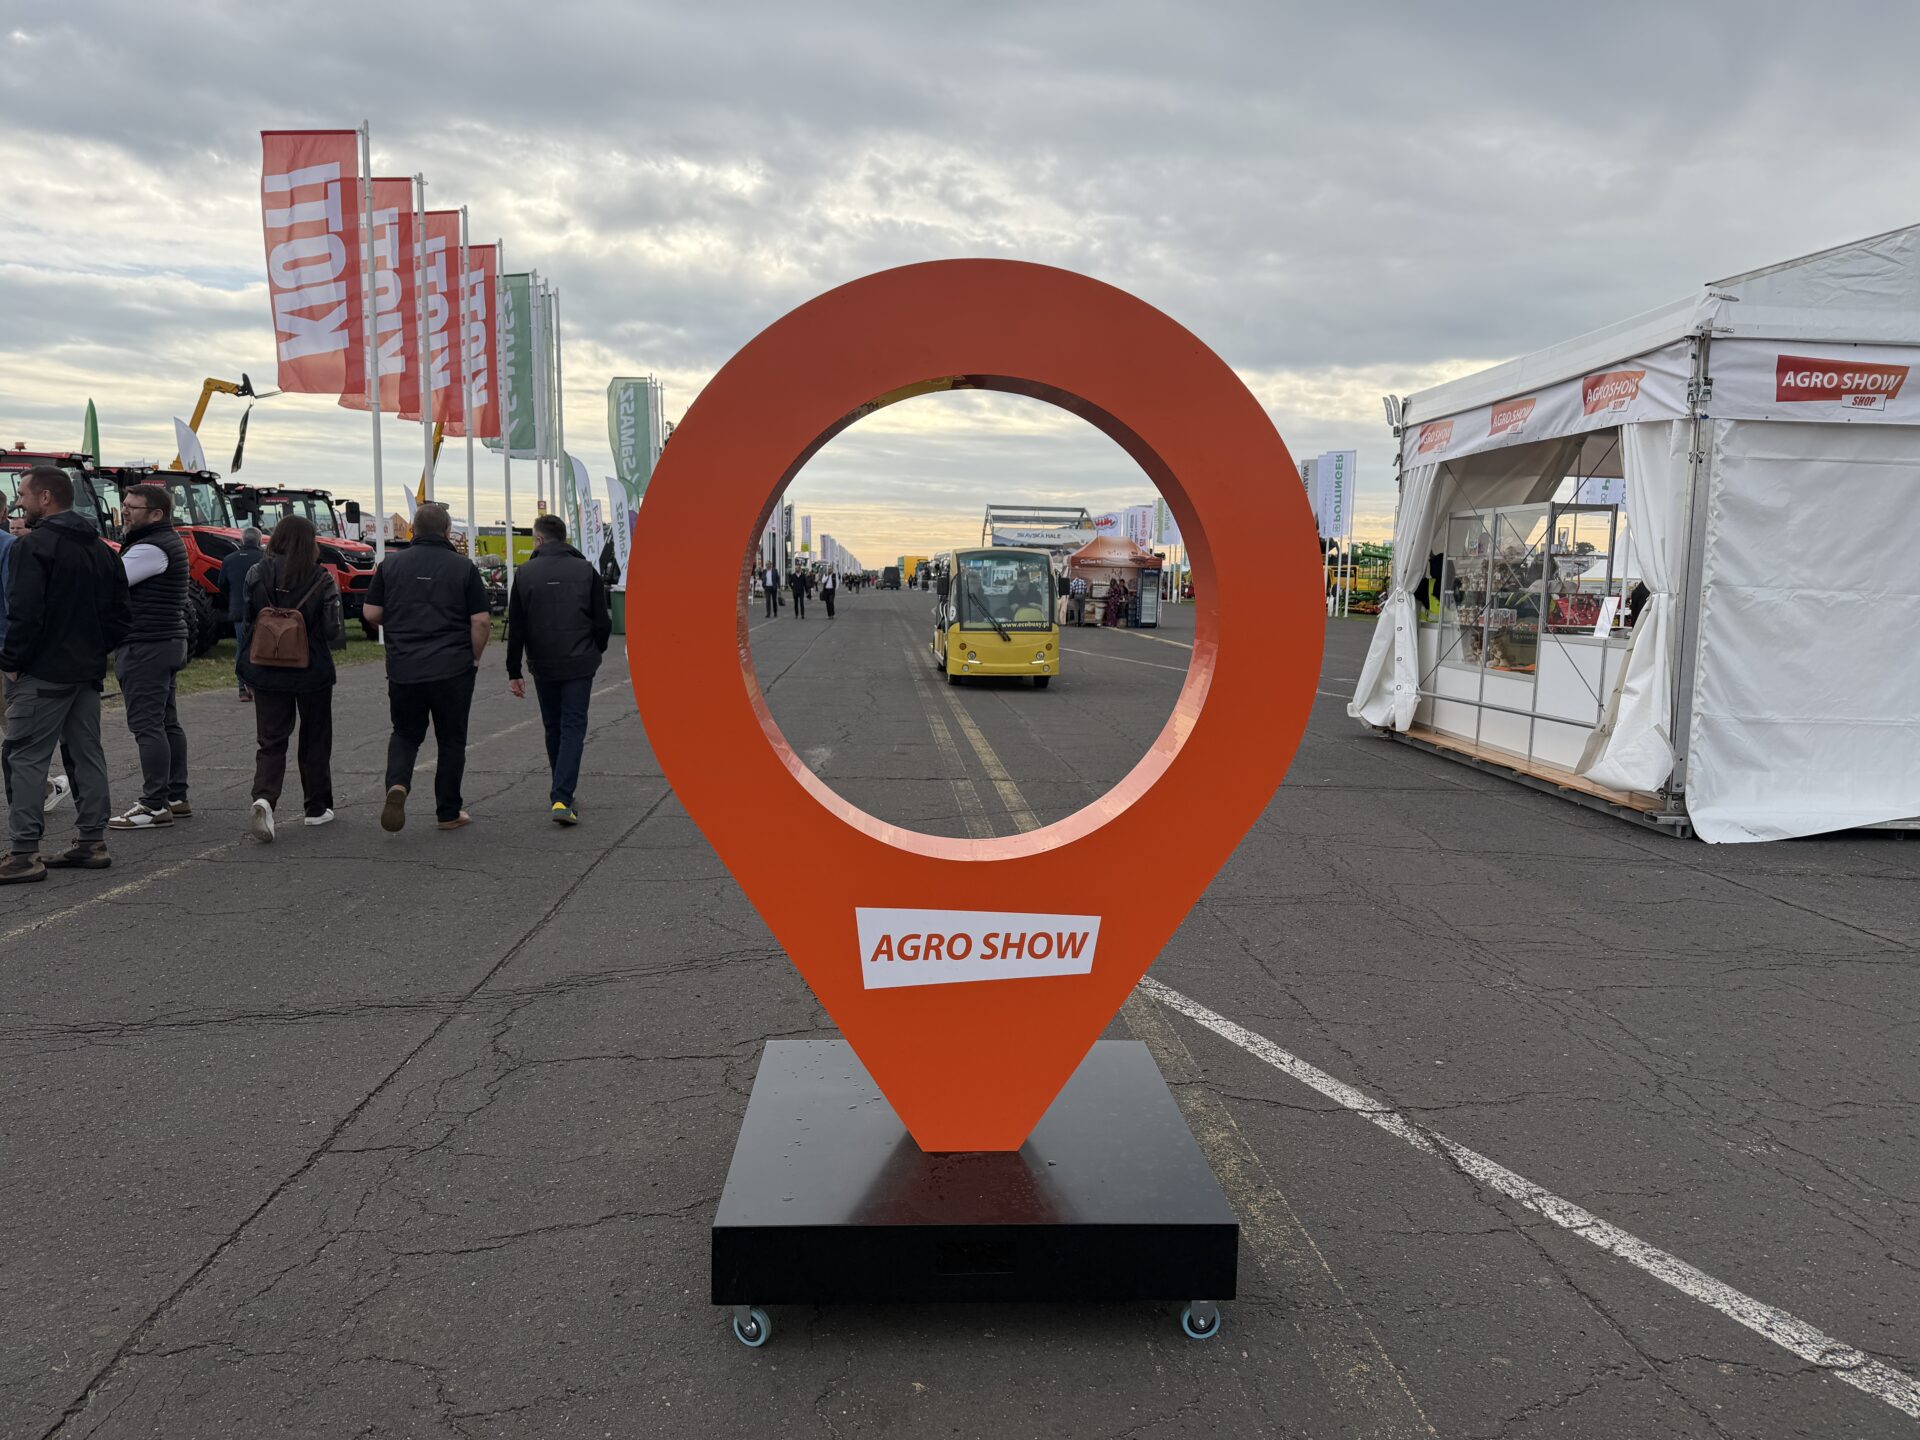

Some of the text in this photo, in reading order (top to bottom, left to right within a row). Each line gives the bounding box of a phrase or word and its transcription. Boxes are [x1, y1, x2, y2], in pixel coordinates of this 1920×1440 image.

[1586, 378, 1639, 402] AGRO SHOW
[1782, 370, 1902, 391] AGRO SHOW
[1852, 396, 1877, 407] SHOP
[1492, 404, 1534, 428] AGRO SHOW
[870, 931, 1090, 962] AGRO SHOW
